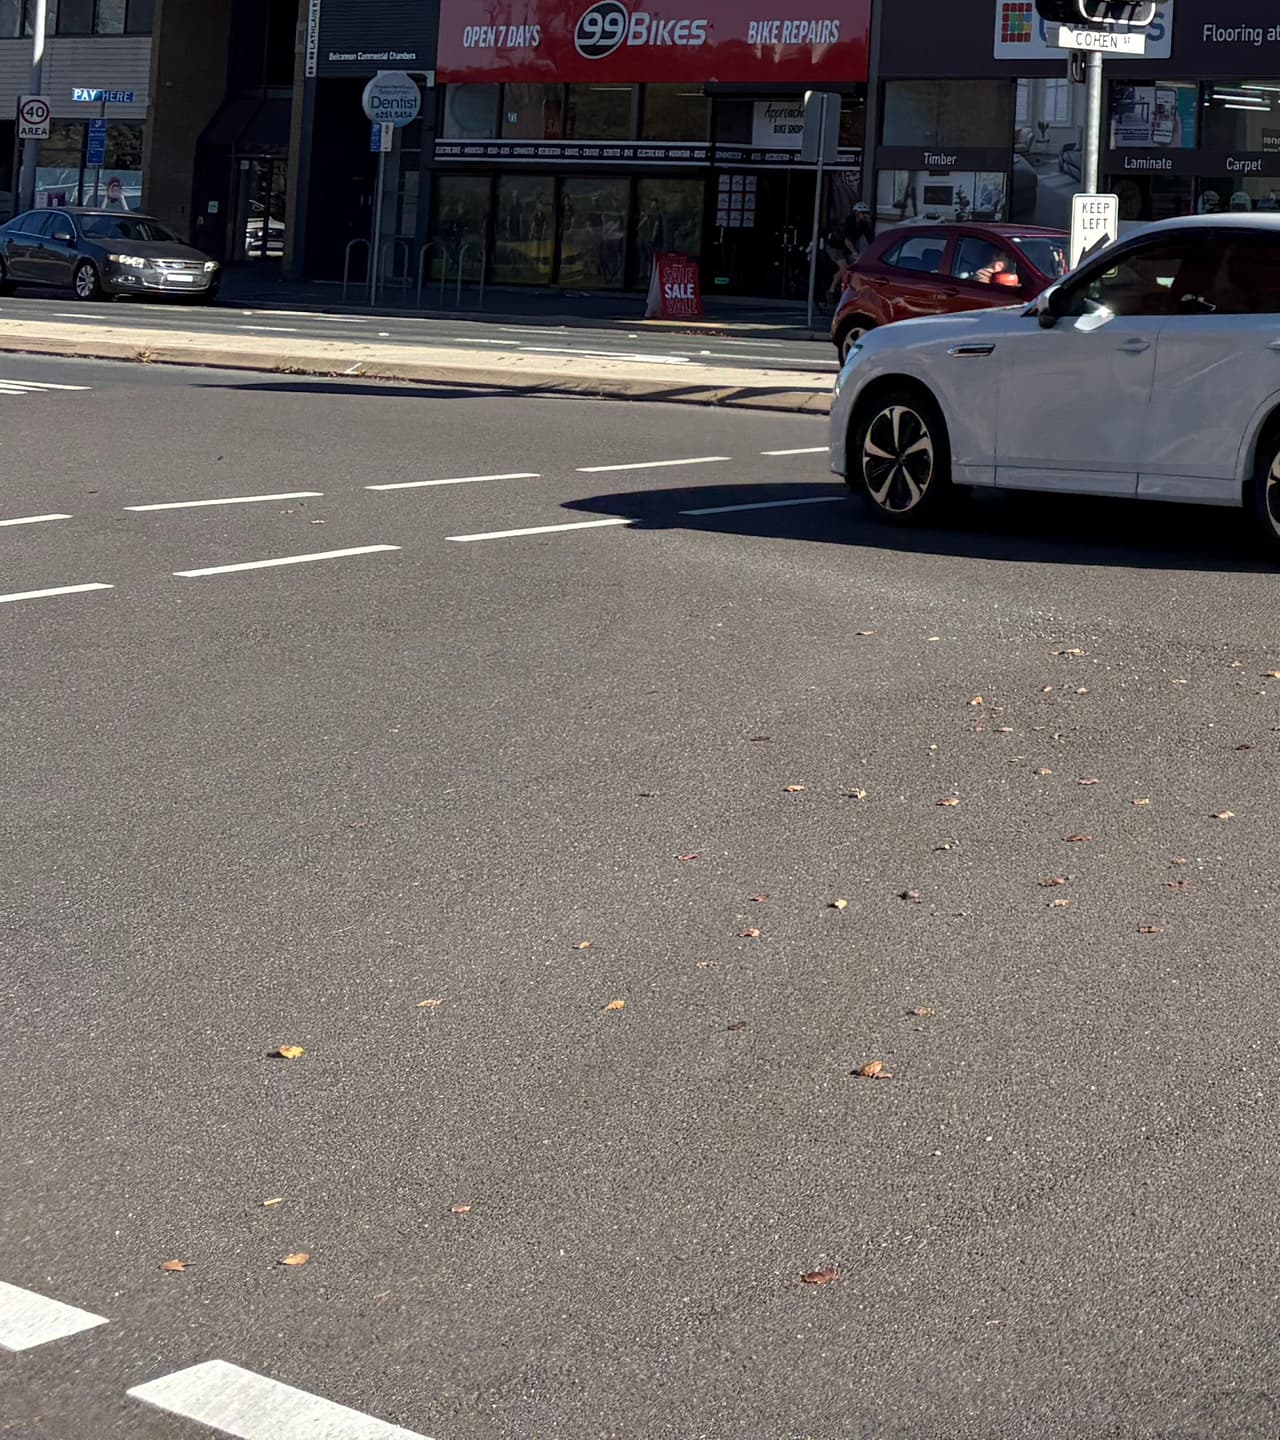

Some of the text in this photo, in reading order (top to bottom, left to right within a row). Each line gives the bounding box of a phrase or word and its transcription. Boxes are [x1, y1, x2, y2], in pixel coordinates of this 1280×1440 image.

[577, 11, 625, 46] 99
[747, 20, 840, 44] BIKE REPAIRS
[1203, 23, 1263, 46] Flooring
[1267, 24, 1280, 41] at
[463, 25, 541, 48] OPEN 7 DAYS
[1075, 32, 1118, 49] COHEN
[73, 88, 132, 102] PAY HERE
[370, 95, 418, 109] Dentist
[25, 105, 46, 118] 40
[20, 126, 49, 136] AREA
[773, 124, 788, 134] BIKE
[924, 152, 957, 166] Timber
[1124, 156, 1173, 170] Laminate
[1226, 156, 1263, 173] Carpet
[1082, 202, 1110, 214] KEEP
[1082, 217, 1108, 230] LEFT
[664, 283, 696, 299] SALE
